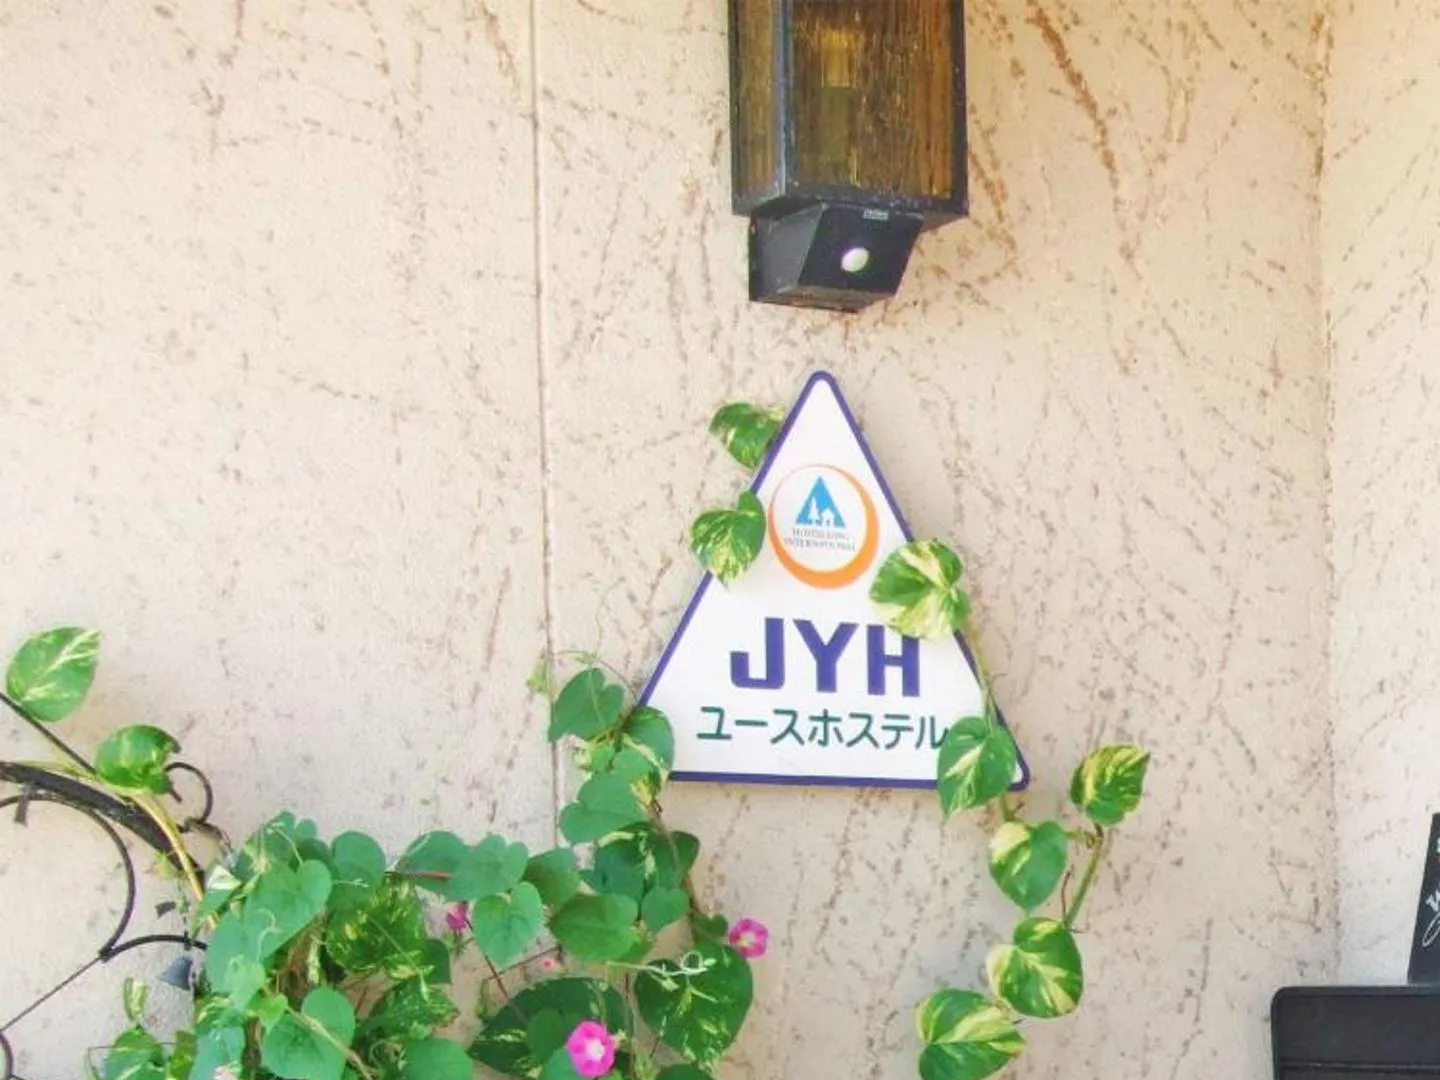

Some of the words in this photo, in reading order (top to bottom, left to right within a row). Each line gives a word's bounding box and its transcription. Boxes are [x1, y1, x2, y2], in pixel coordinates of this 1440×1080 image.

[729, 617, 920, 697] JYH
[696, 706, 950, 750] ユースホステル
